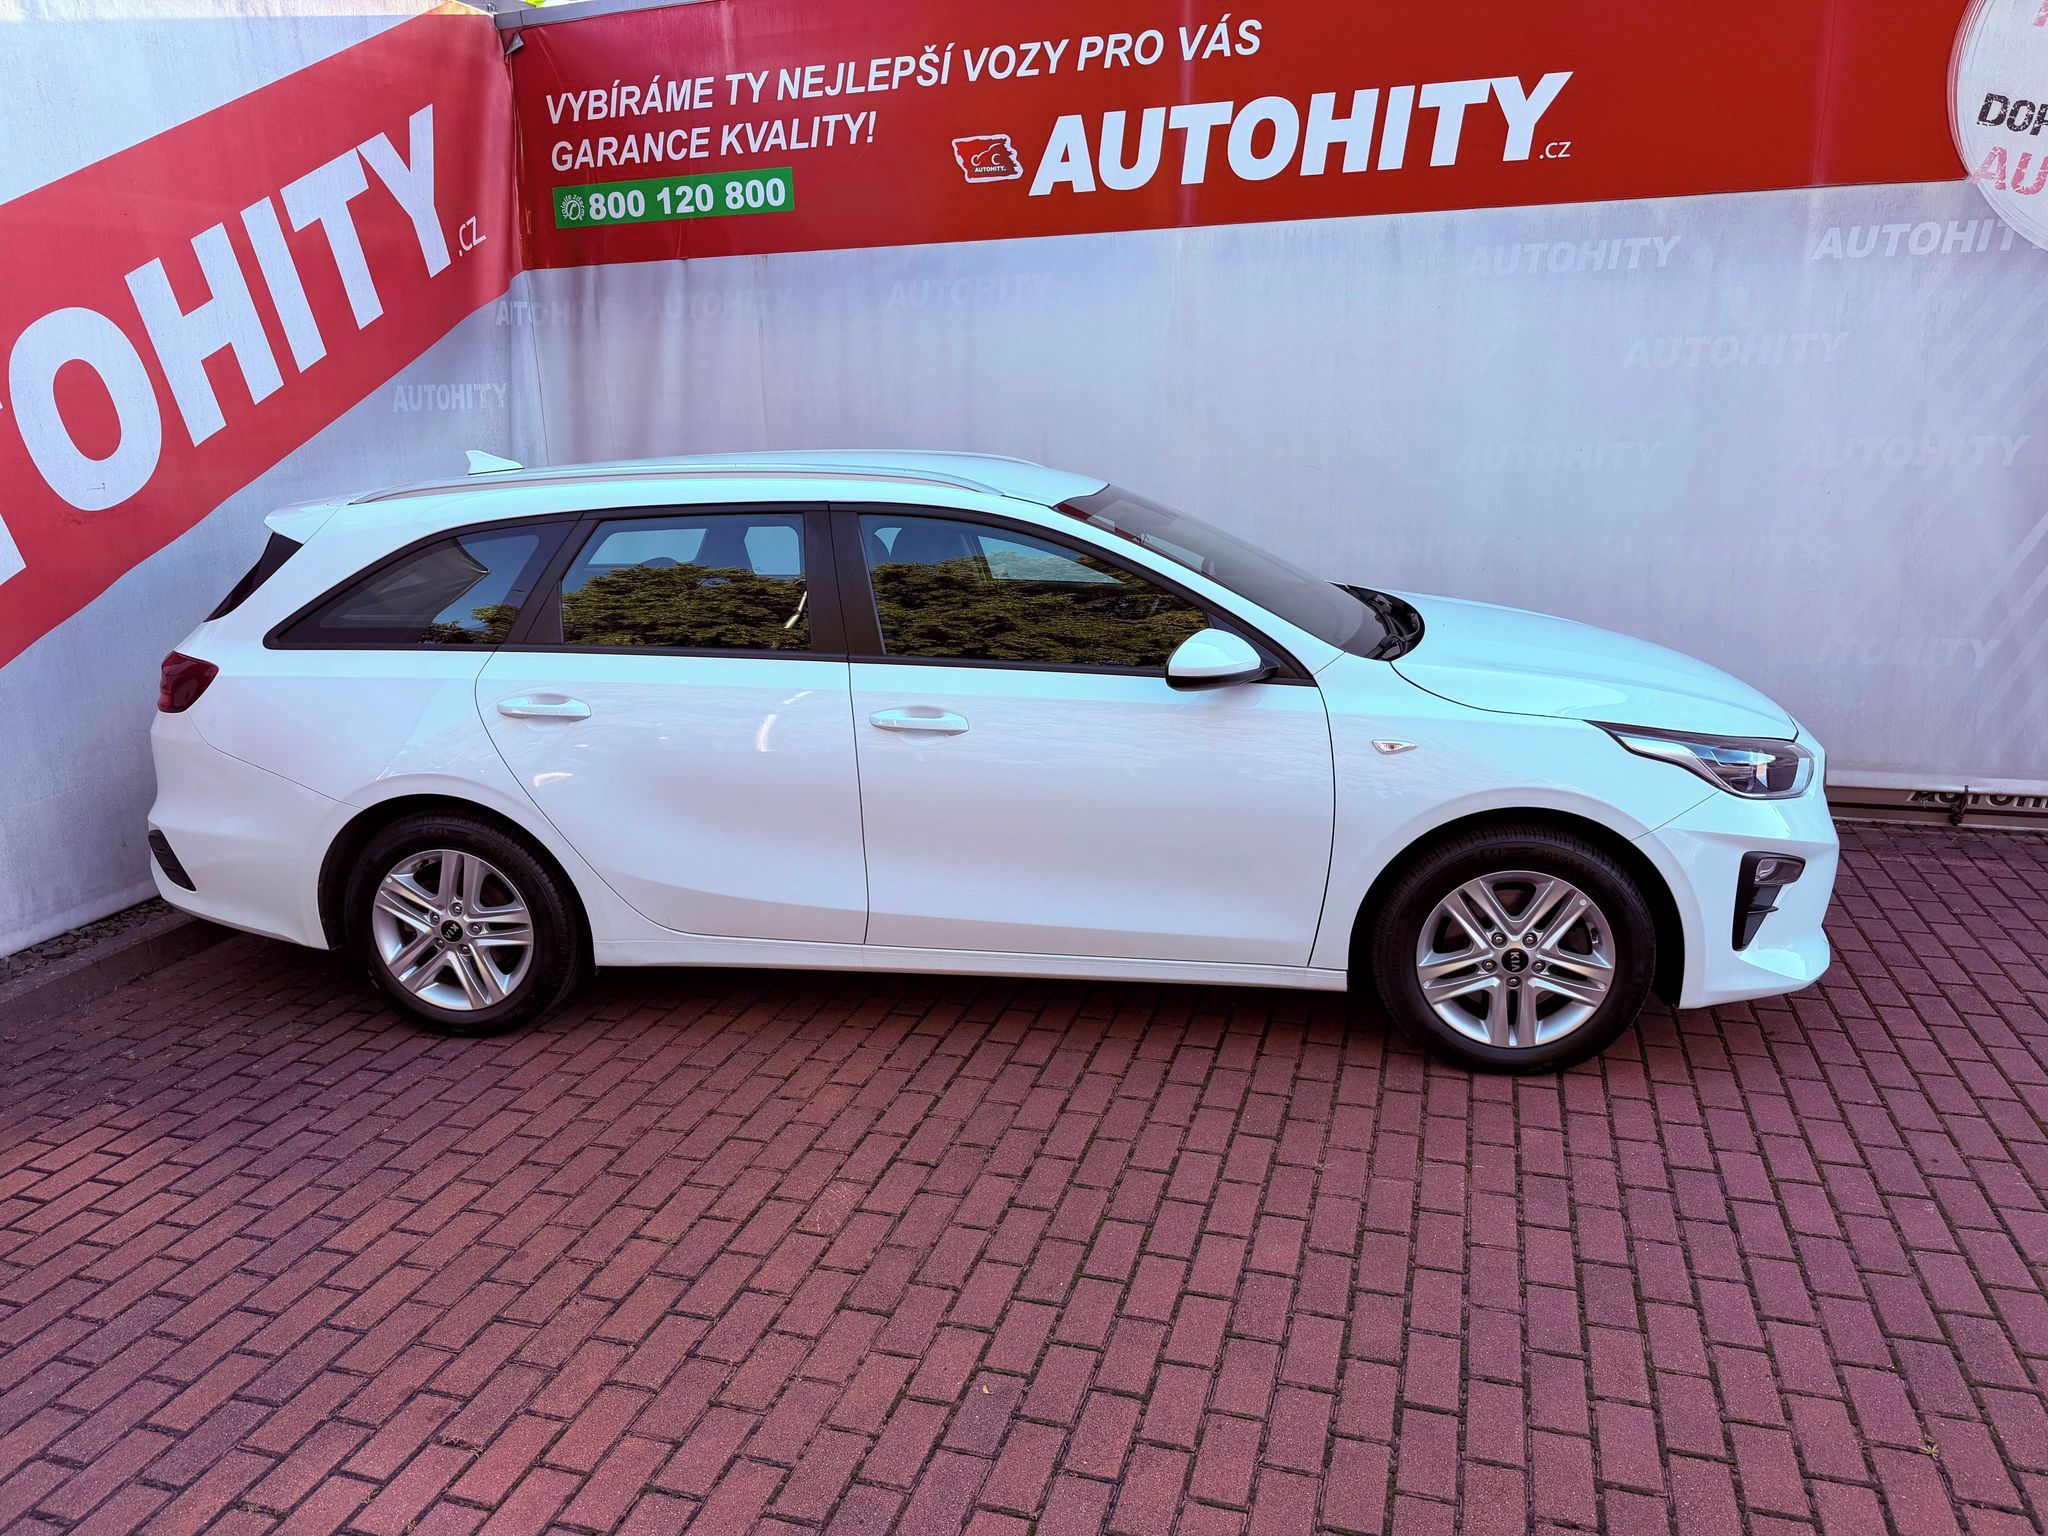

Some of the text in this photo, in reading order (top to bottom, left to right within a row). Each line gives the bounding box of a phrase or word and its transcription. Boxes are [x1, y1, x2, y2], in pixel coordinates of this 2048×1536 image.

[546, 14, 1263, 124] VYBÍRÁME TY NEJLEPŠÍ VOZY PRO VÁS
[552, 111, 877, 171] GARANCE KVALITY!
[589, 178, 785, 220] 800 120 800
[1468, 236, 1682, 277] AUTOHITY
[1810, 218, 2047, 261] AUTOHIT
[392, 382, 509, 412] AUTOHITY
[444, 923, 460, 940] KIA
[1510, 951, 1520, 972] KIA
